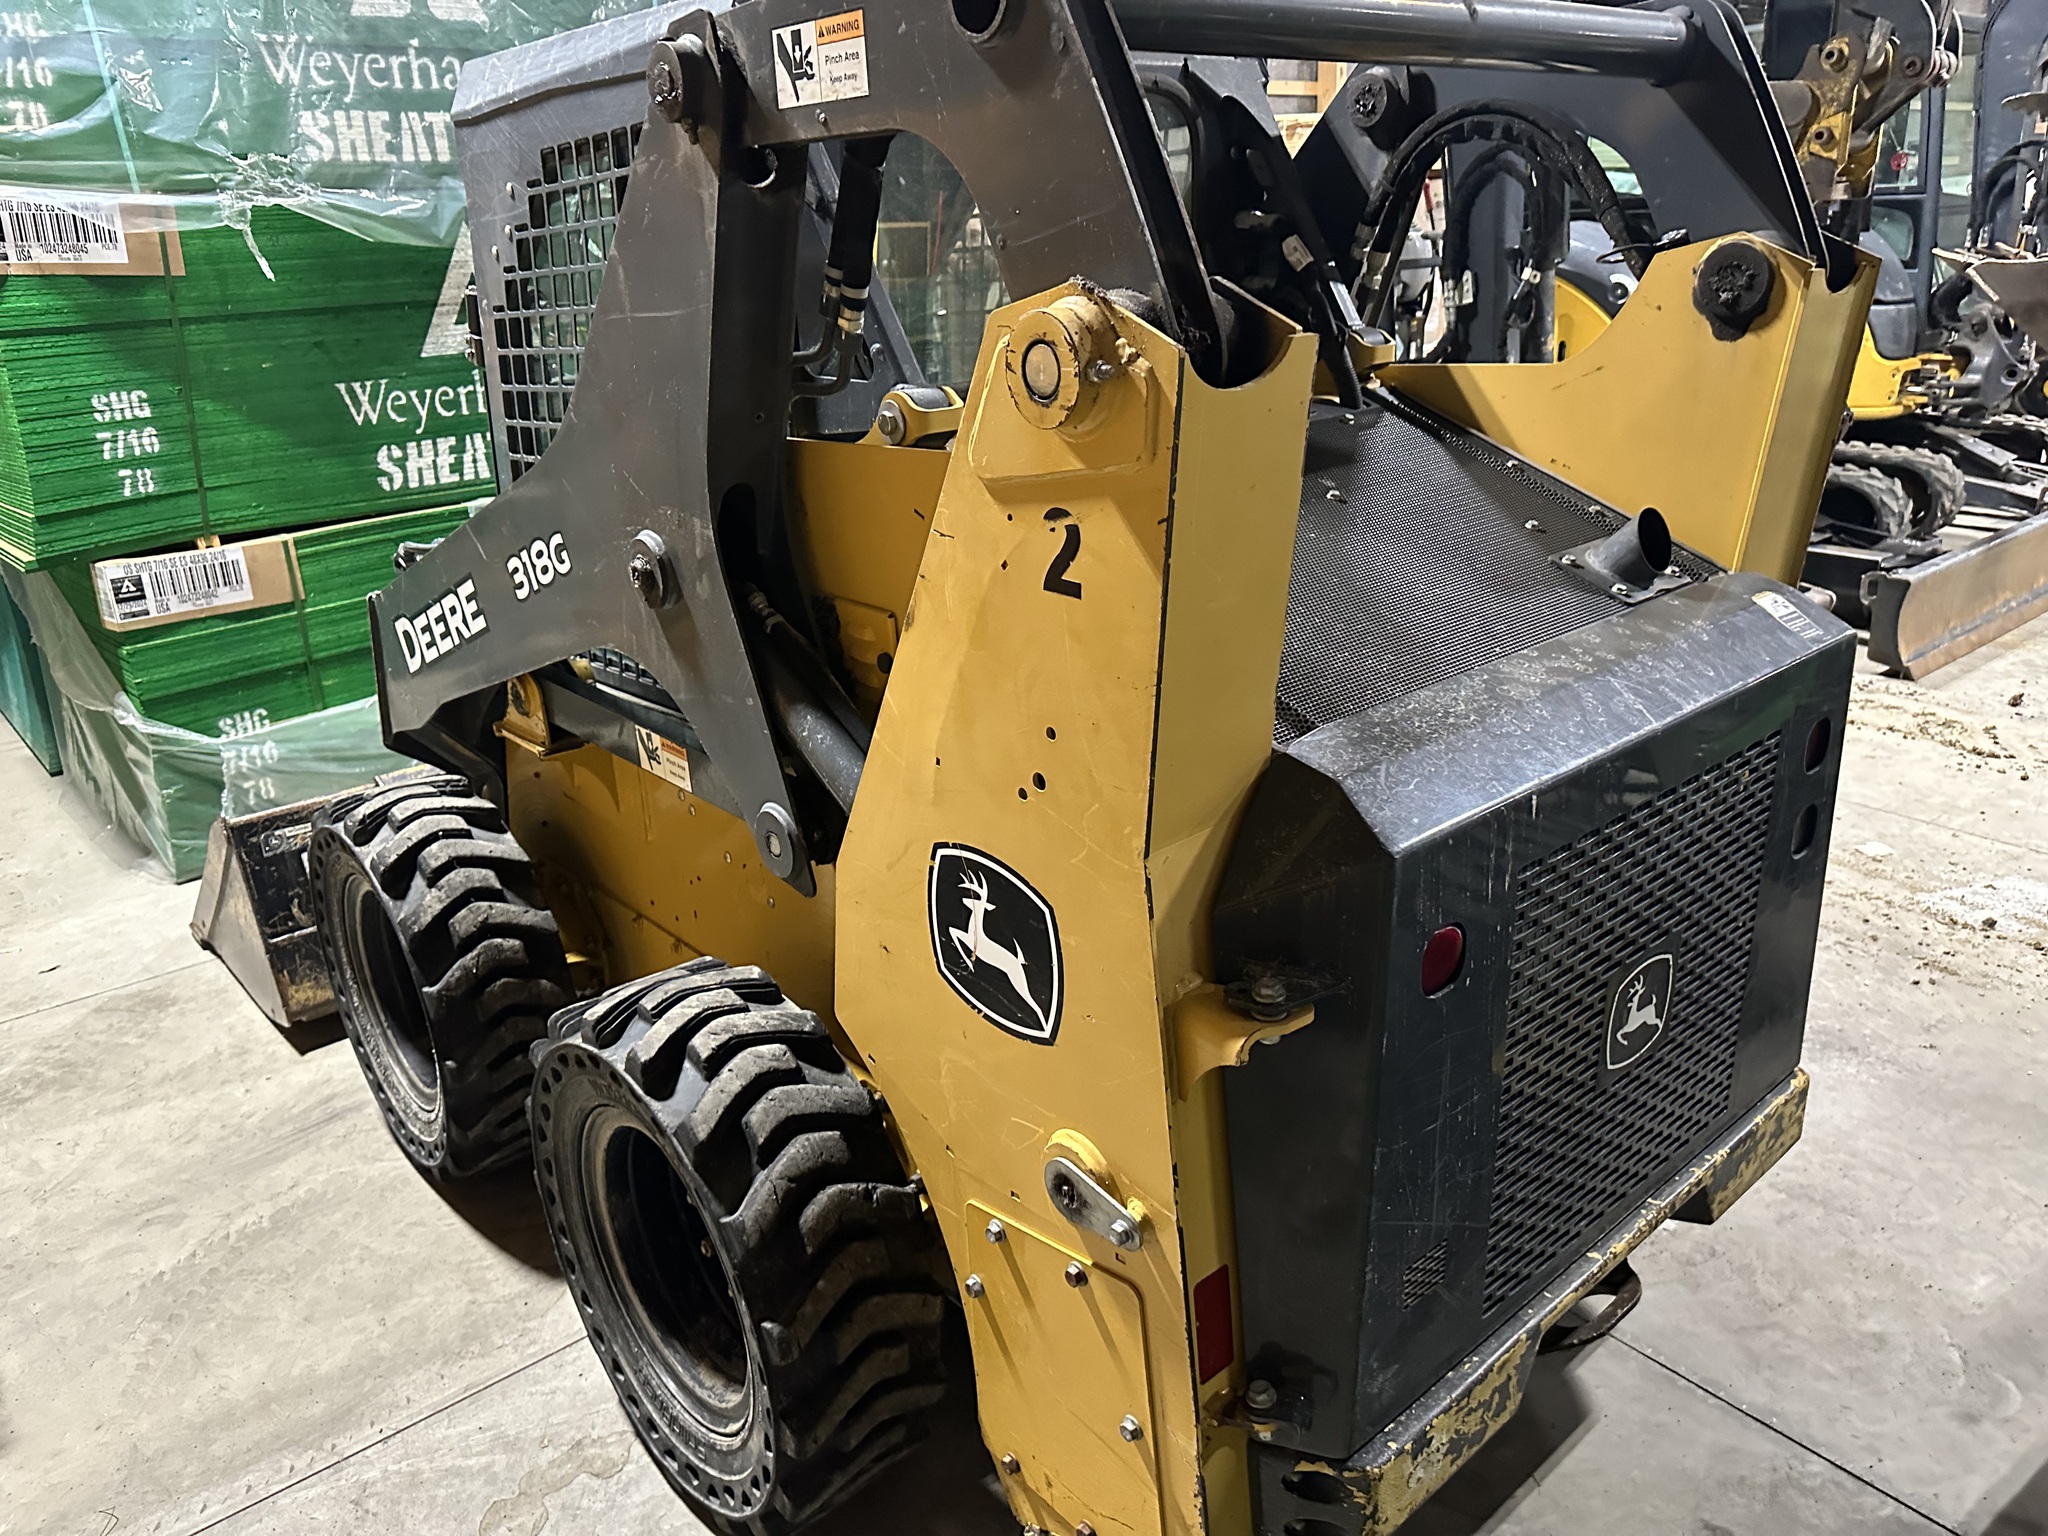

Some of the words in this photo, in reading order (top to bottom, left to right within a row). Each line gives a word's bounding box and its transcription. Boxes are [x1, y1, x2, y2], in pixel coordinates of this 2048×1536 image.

[825, 19, 859, 36] WARNING
[253, 33, 462, 102] Weyerha
[825, 54, 843, 65] Pinch
[844, 51, 859, 61] Area
[830, 74, 843, 84] Keep
[843, 73, 857, 82] Away
[298, 110, 452, 162] SHEAT
[15, 249, 33, 261] USA
[91, 390, 152, 422] SHG
[95, 427, 159, 460] 7/16
[377, 432, 491, 491] SHEA
[118, 468, 154, 496] 78
[153, 558, 168, 570] 7/16
[168, 557, 179, 568] SE
[179, 555, 188, 567] ES
[1043, 507, 1082, 600] 2
[155, 602, 171, 614] USA
[395, 579, 487, 674] DEERE
[507, 533, 572, 600] 318G
[218, 708, 270, 739] SHG
[243, 777, 275, 805] 78
